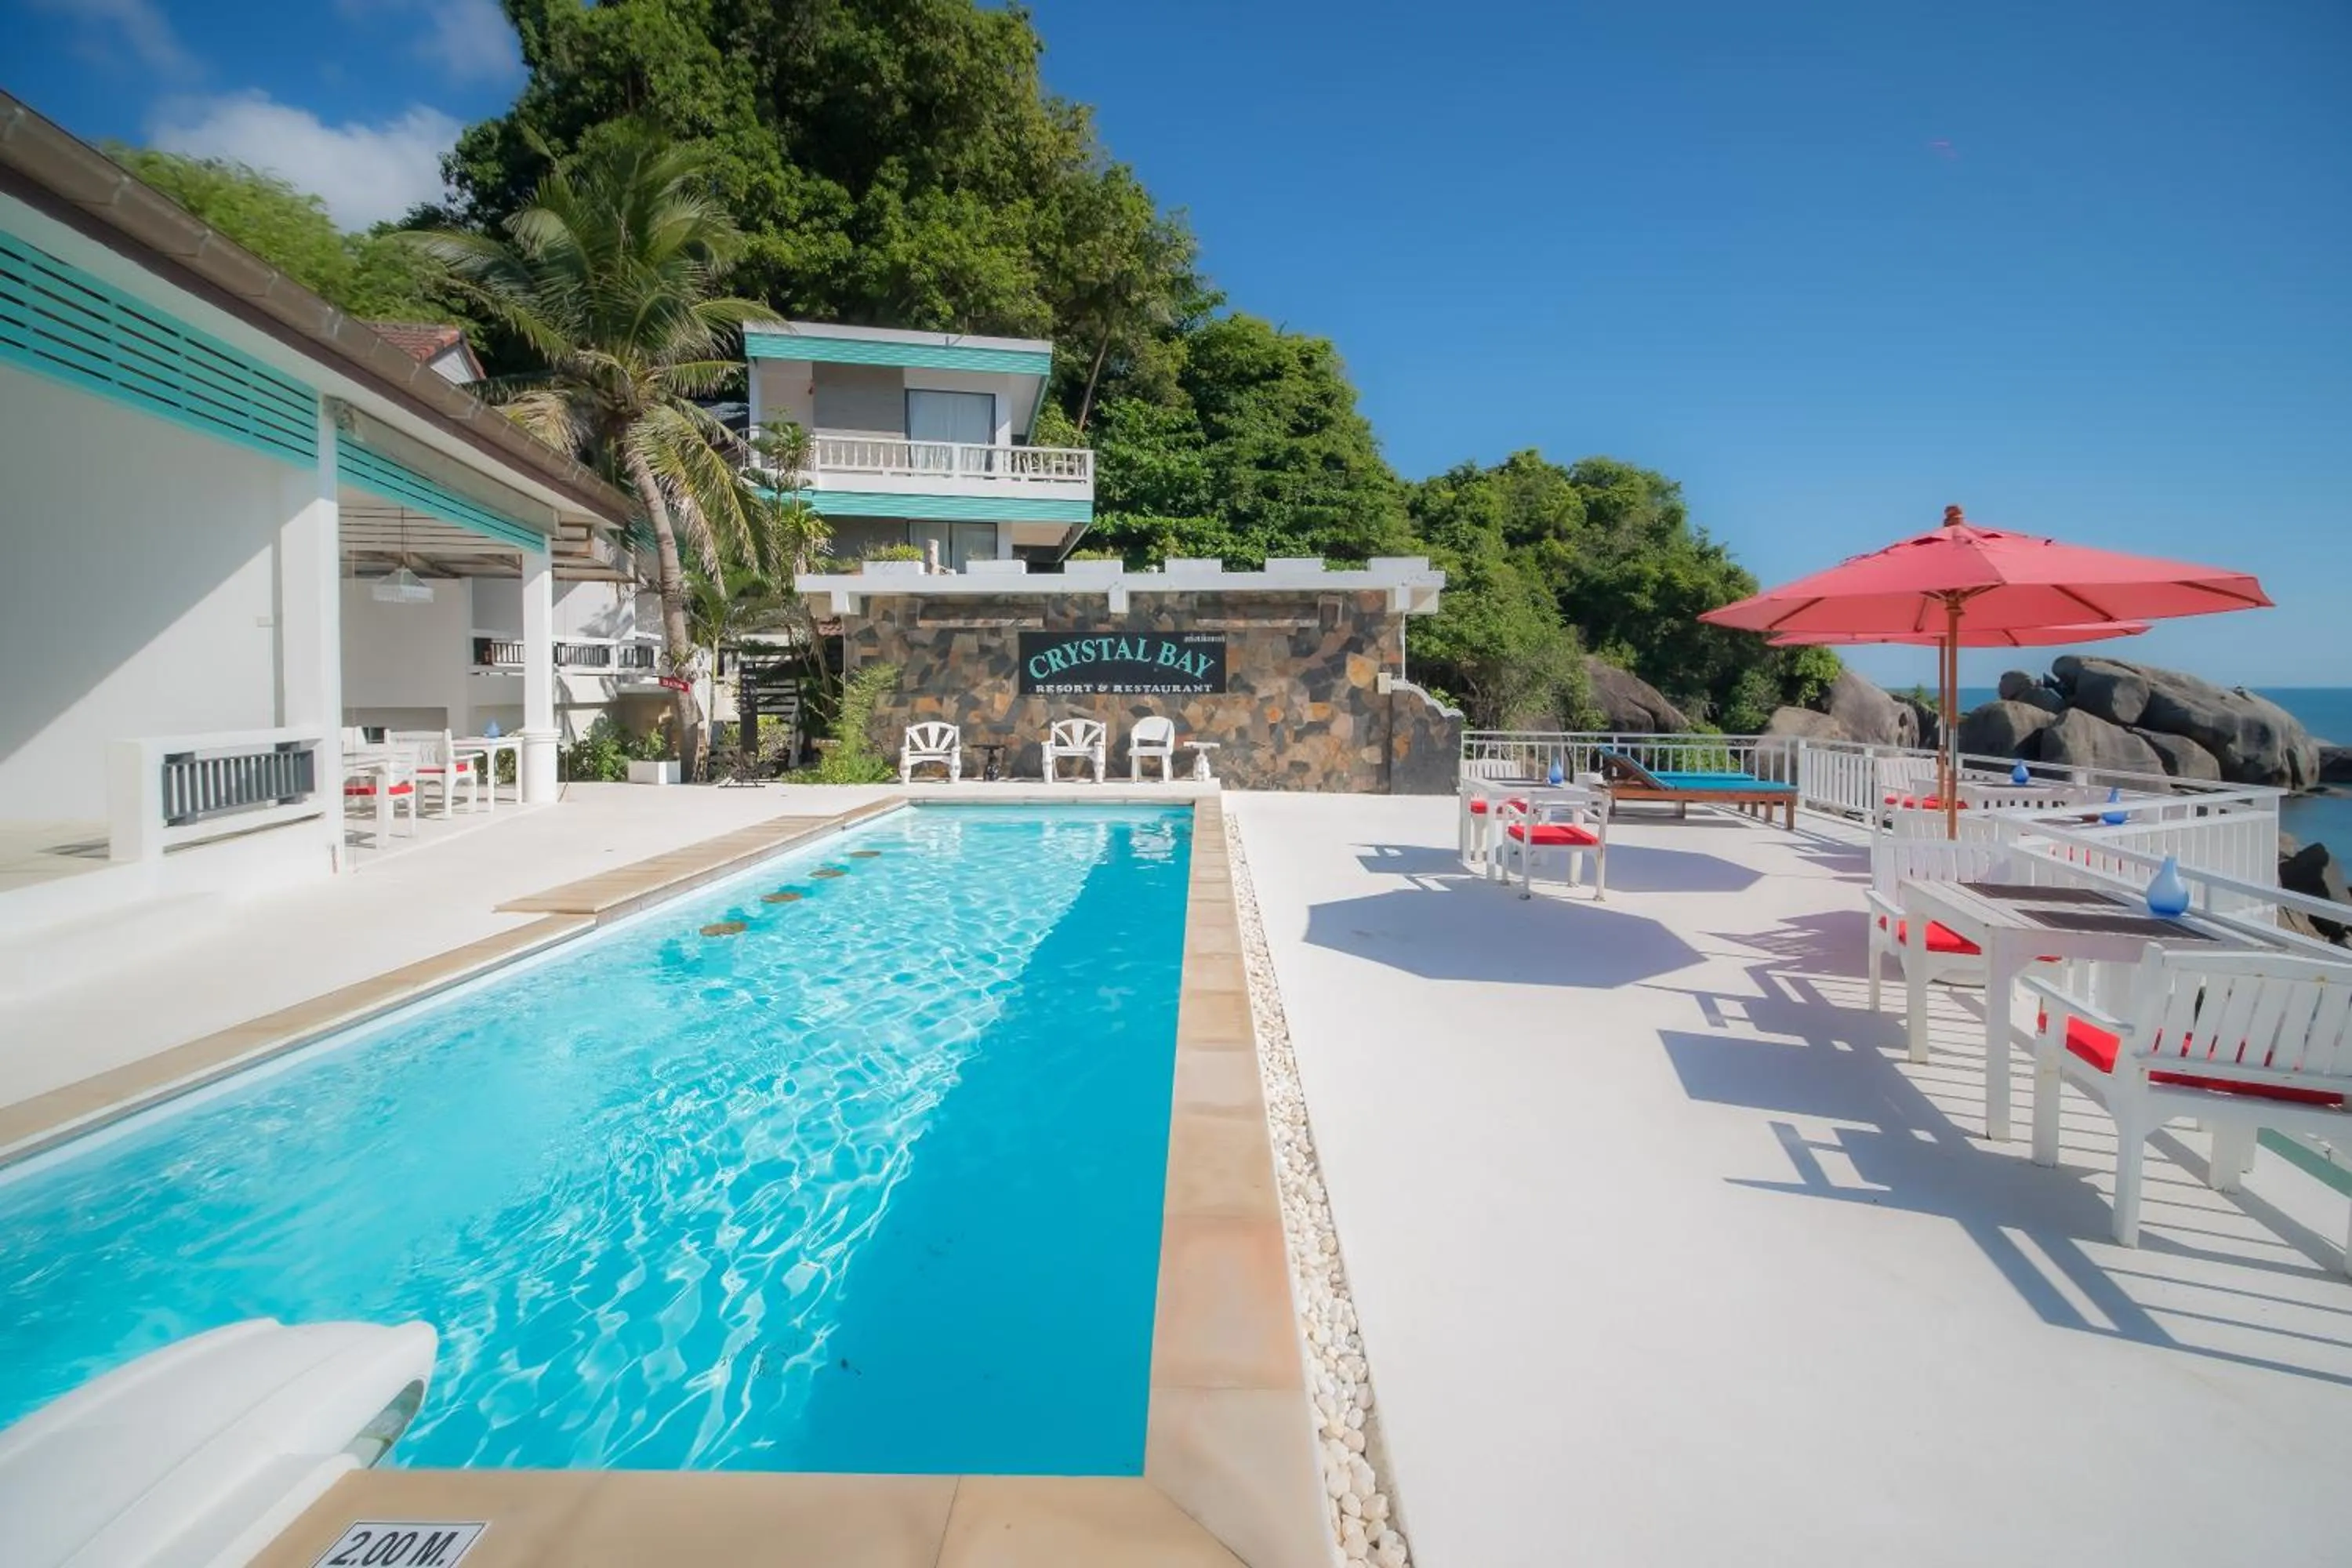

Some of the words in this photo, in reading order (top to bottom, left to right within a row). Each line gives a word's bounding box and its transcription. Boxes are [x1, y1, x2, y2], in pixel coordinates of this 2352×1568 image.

[1029, 637, 1152, 679] CRYSTAL
[1157, 641, 1214, 679] BAY
[1036, 684, 1094, 693] RESORT
[1097, 683, 1109, 693] &
[1113, 684, 1212, 693] RESTAURANT
[328, 1531, 419, 1566] 2.00
[406, 1531, 459, 1566] M.
